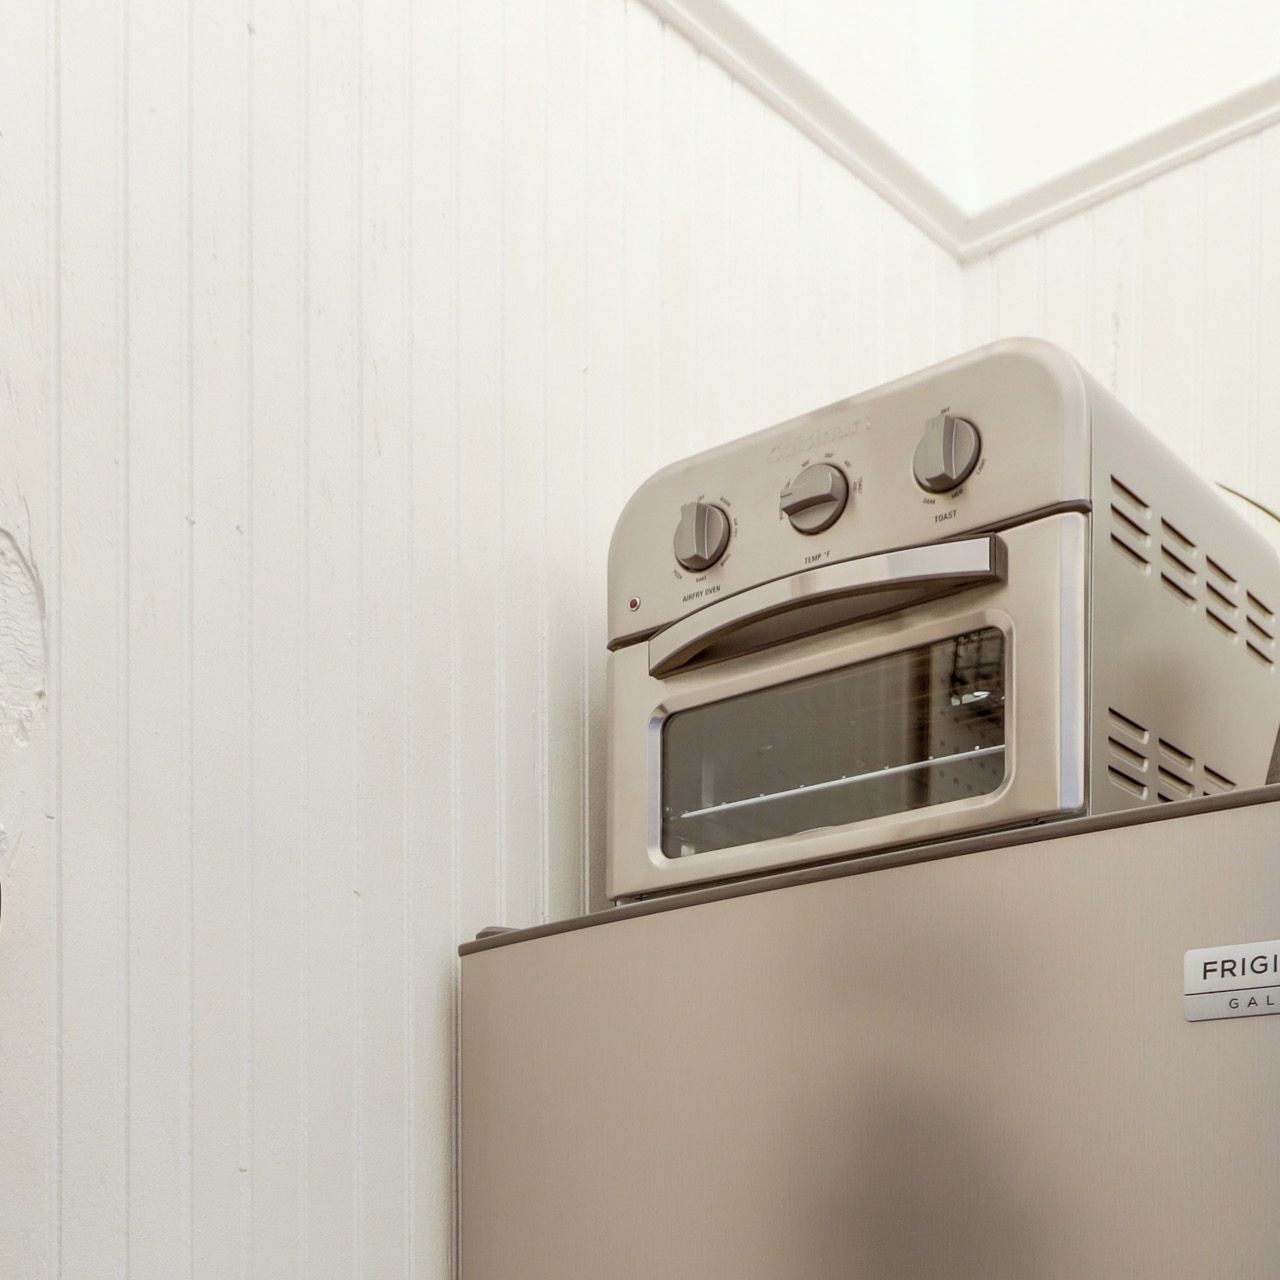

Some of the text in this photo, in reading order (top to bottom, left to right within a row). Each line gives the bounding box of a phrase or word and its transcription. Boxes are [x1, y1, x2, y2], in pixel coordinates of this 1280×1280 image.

[934, 509, 958, 524] TOAST
[804, 552, 822, 565] TEMP
[683, 585, 720, 602] AIRFRY OVEN
